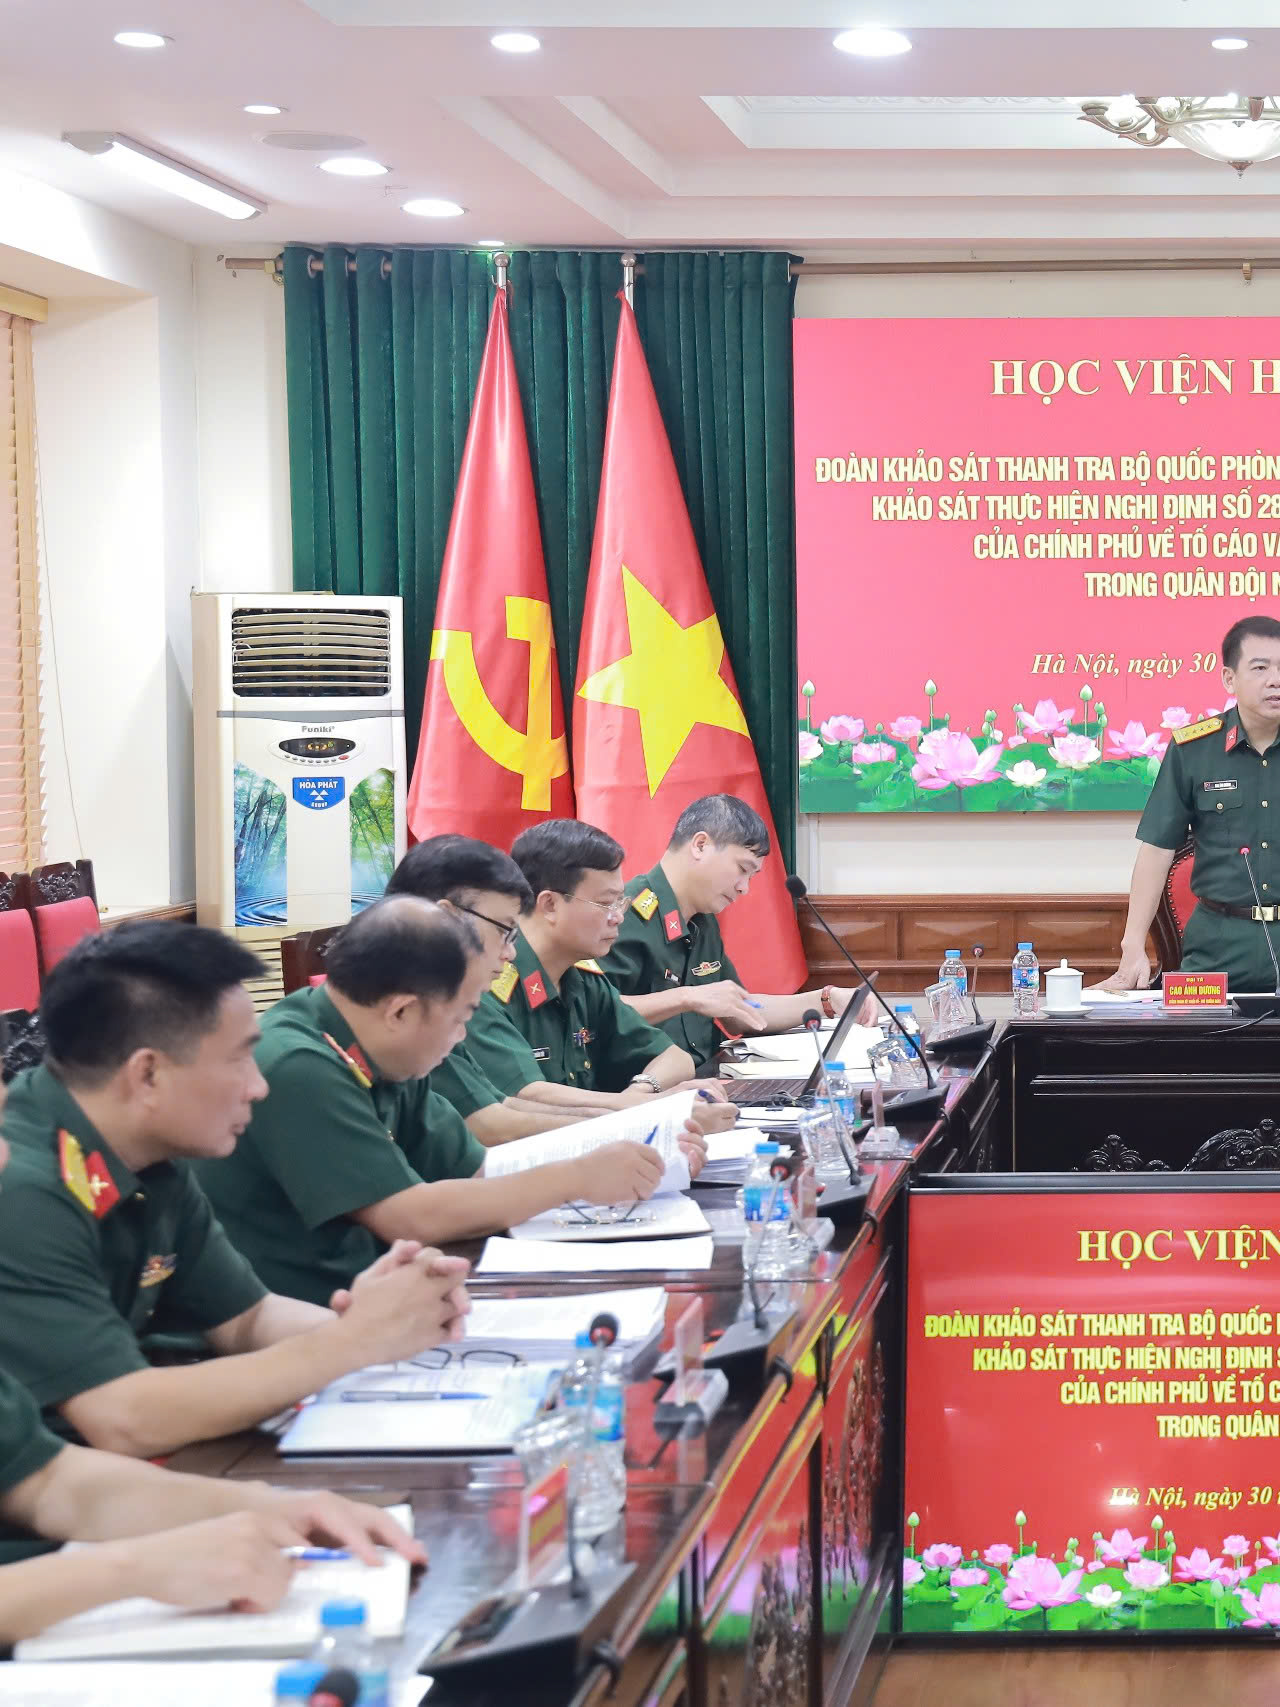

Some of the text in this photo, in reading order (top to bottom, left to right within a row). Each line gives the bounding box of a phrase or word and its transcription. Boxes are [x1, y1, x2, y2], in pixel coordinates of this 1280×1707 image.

[990, 360, 1099, 405] HỌC
[1113, 353, 1235, 404] VIỆN
[816, 452, 877, 482] ĐOÀN
[883, 449, 943, 482] KHẢO
[949, 452, 991, 482] SÁT
[995, 457, 1069, 481] THANH
[1074, 457, 1115, 481] TRA
[1121, 451, 1150, 486] BỘ
[1157, 447, 1215, 483] QUỐC
[873, 488, 932, 520] KHẢO
[939, 491, 980, 520] SÁT
[985, 493, 1041, 525] THỰC
[1048, 490, 1099, 525] HIỆN
[1105, 495, 1157, 524] NGHỊ
[1163, 495, 1216, 524] ĐỊNH
[1222, 486, 1251, 518] SỐ
[974, 526, 1019, 559] CỦA
[1024, 529, 1092, 558] CHÍNH
[1098, 525, 1142, 558] PHỦ
[1148, 525, 1174, 557] VỀ
[1180, 524, 1207, 558] TỐ
[1213, 528, 1257, 557] CÁO
[1084, 572, 1157, 597] TRONG
[1163, 567, 1224, 599] QUÂN
[1229, 567, 1266, 601] ĐỘI
[1031, 654, 1065, 673] Hà
[1072, 654, 1119, 678] Nội,
[1128, 653, 1182, 678] ngày
[1189, 653, 1216, 672] 30
[300, 779, 338, 789] HÒA PHÁT
[1169, 985, 1183, 996] CAO
[1077, 1230, 1172, 1269] HỌC
[924, 1310, 979, 1337] ĐOÀN
[983, 1307, 1036, 1337] KHẢO
[1040, 1310, 1078, 1337] SÁT
[1080, 1314, 1145, 1336] THANH
[1149, 1313, 1186, 1336] TRA
[1189, 1309, 1216, 1340] BỘ
[1220, 1305, 1272, 1338] QUỐC
[973, 1341, 1026, 1370] KHẢO
[1030, 1343, 1068, 1370] SÁT
[1071, 1345, 1121, 1375] THỰC
[1125, 1343, 1171, 1374] HIỆN
[1175, 1347, 1221, 1374] NGHỊ
[1225, 1346, 1272, 1374] ĐỊNH
[1061, 1374, 1101, 1404] CỦA
[1105, 1376, 1164, 1404] CHÍNH
[1169, 1373, 1208, 1403] PHỦ
[1212, 1374, 1236, 1403] VỀ
[1240, 1373, 1265, 1403] TỐ
[1156, 1415, 1221, 1437] TRONG
[1225, 1410, 1279, 1440] QUÂN
[1144, 1487, 1187, 1510] Nội,
[1194, 1487, 1242, 1510] ngày
[1247, 1486, 1272, 1505] 30
